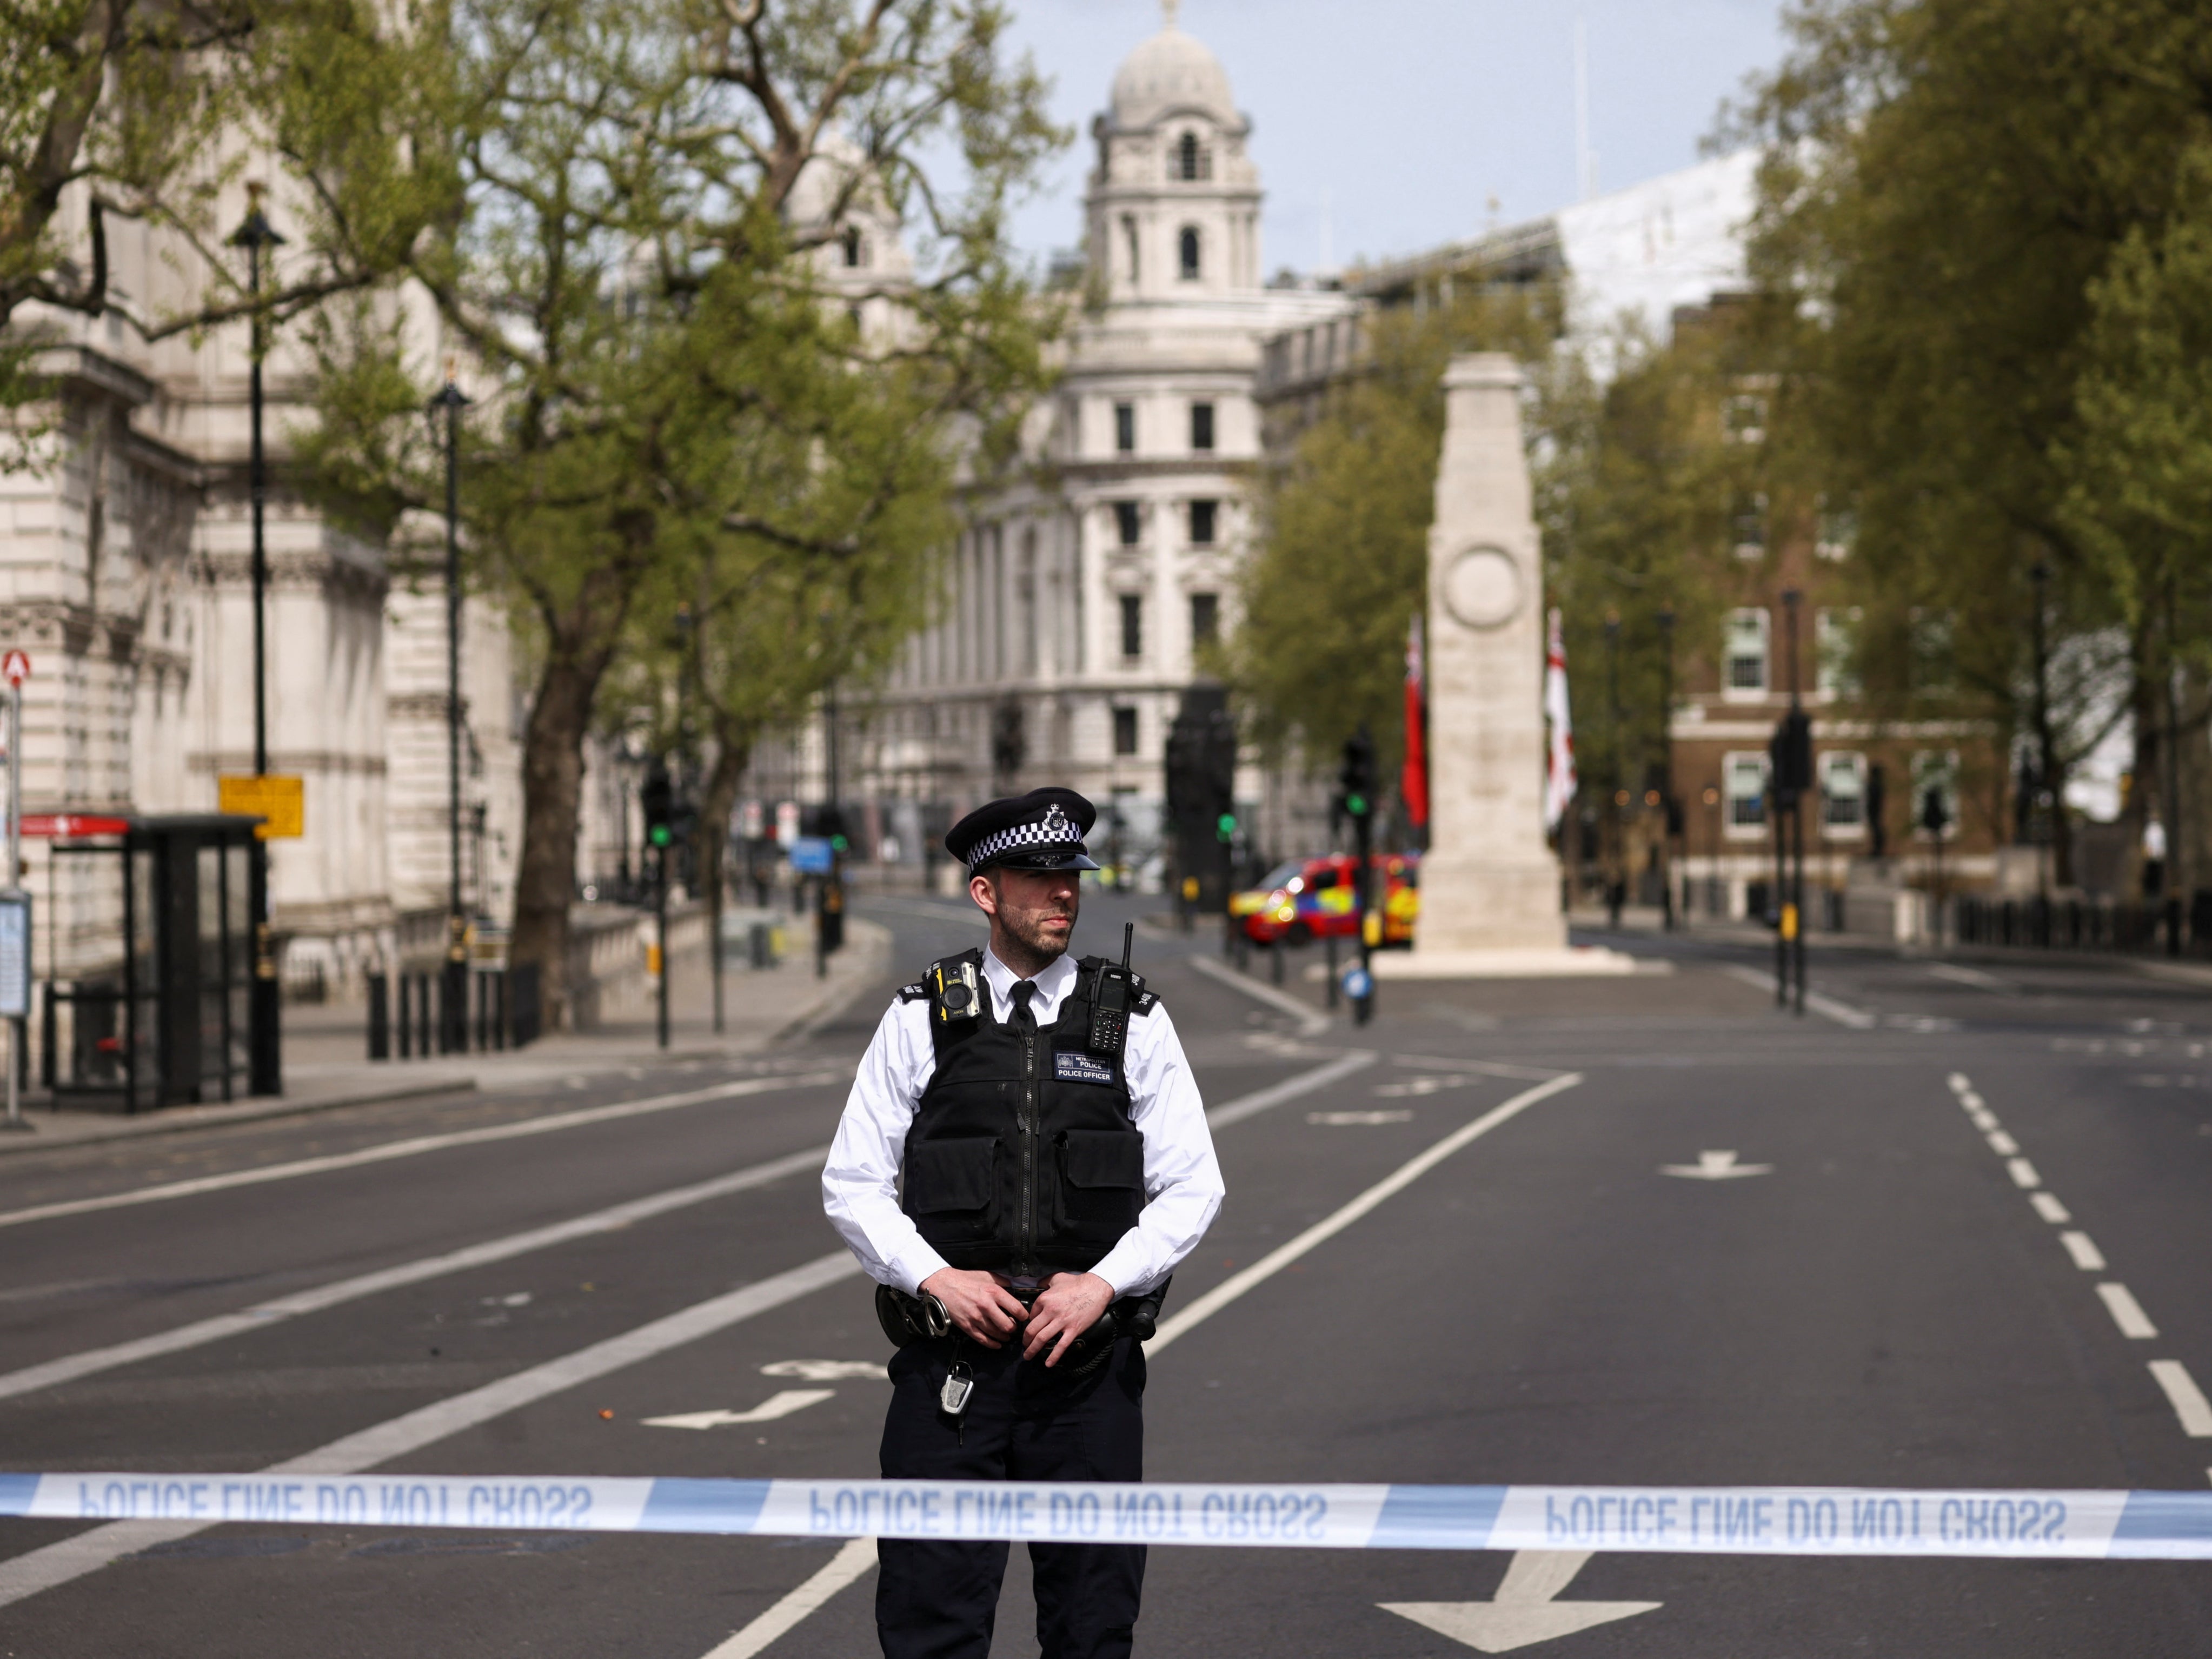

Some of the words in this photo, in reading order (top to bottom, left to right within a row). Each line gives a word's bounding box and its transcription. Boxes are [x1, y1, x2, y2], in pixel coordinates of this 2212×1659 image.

[1132, 973, 1140, 986] 3400
[1139, 993, 1152, 1005] 3400
[1083, 1072, 1110, 1080] OFFICER
